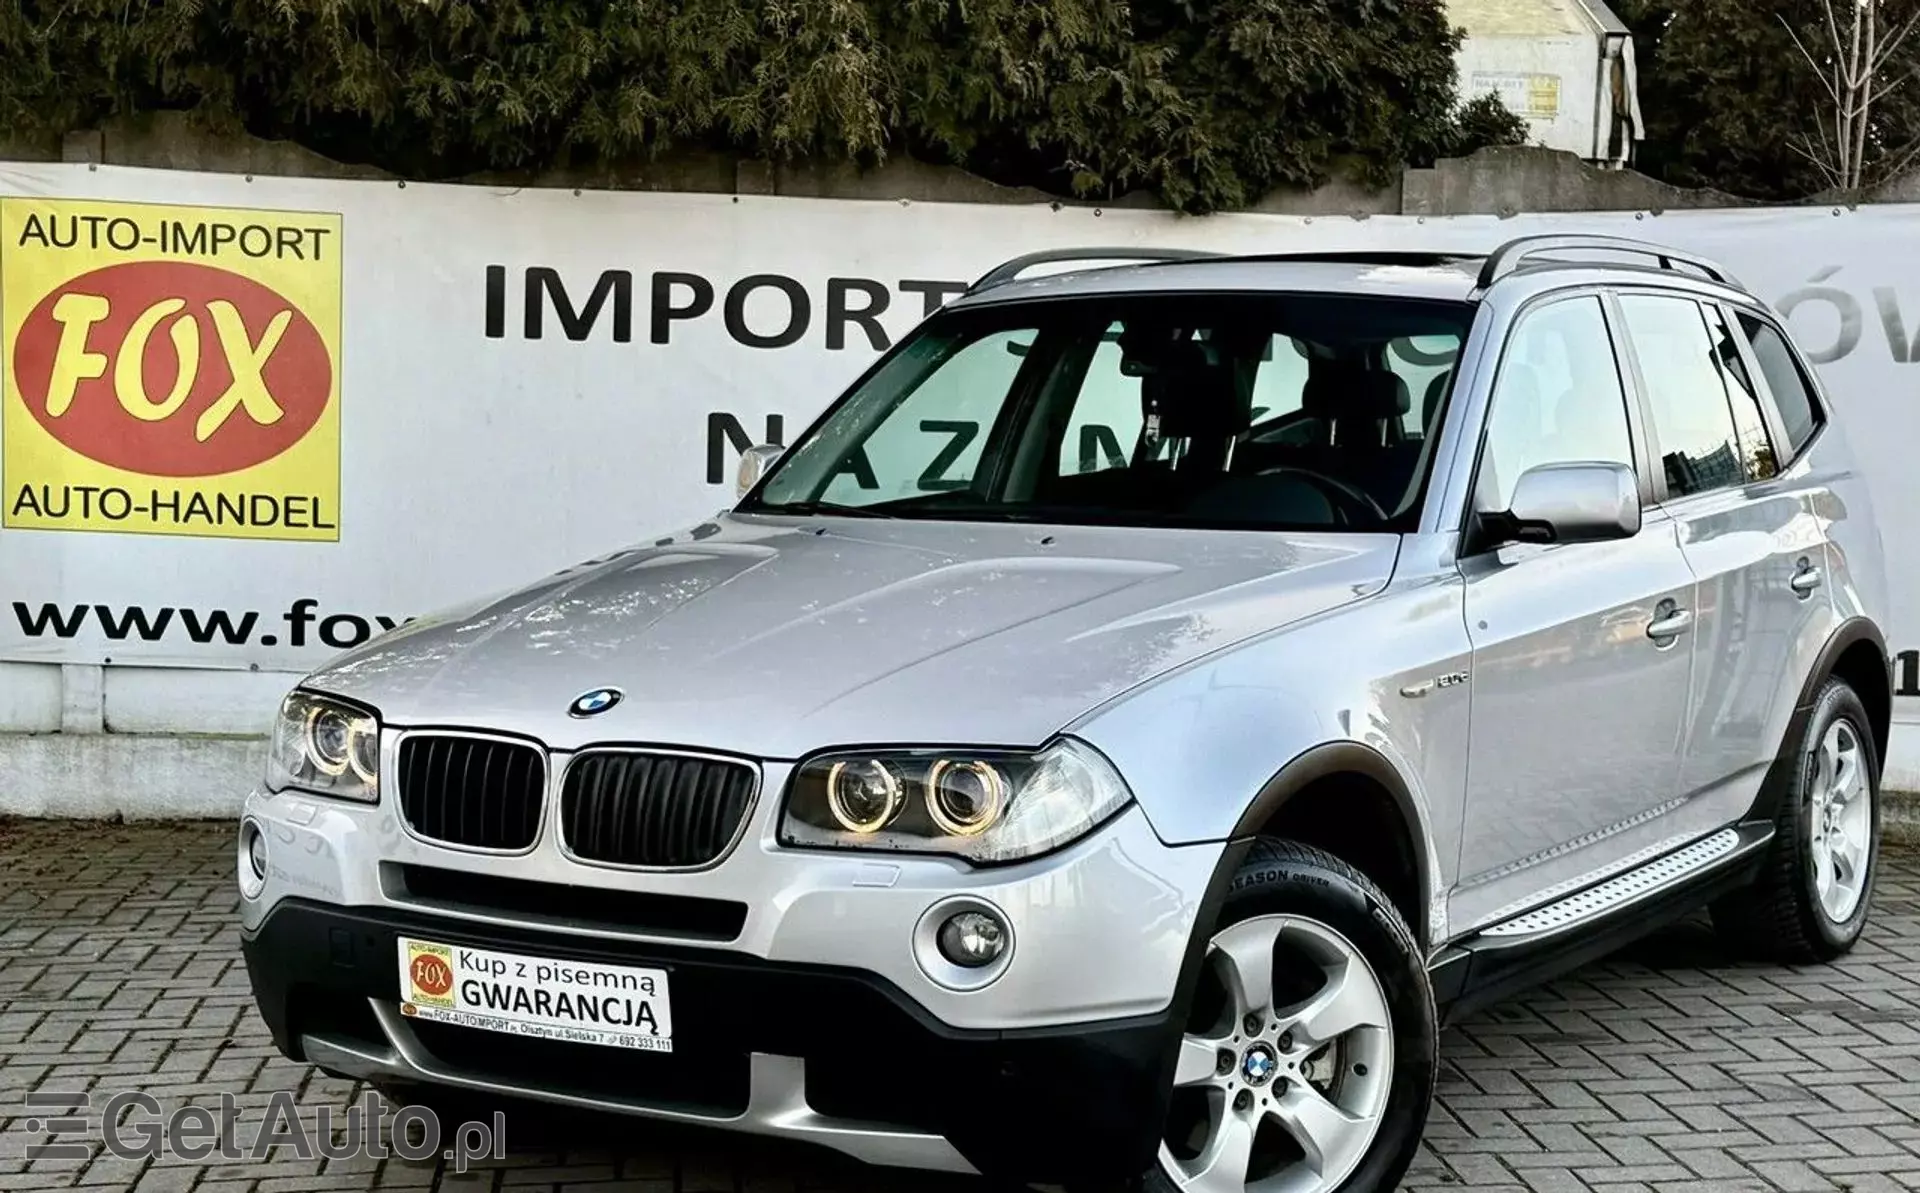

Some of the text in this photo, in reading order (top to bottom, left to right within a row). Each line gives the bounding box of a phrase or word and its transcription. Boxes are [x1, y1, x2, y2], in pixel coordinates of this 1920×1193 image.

[18, 213, 331, 261] AUTO-IMPORT
[485, 264, 969, 351] IMPORT
[44, 292, 294, 443] FOX
[11, 483, 336, 530] AUTO-HANDEL
[415, 960, 448, 989] FOX
[460, 949, 656, 997] Kup z pisemną
[461, 978, 660, 1036] GWARANCJĄ
[656, 1039, 671, 1051] 111
